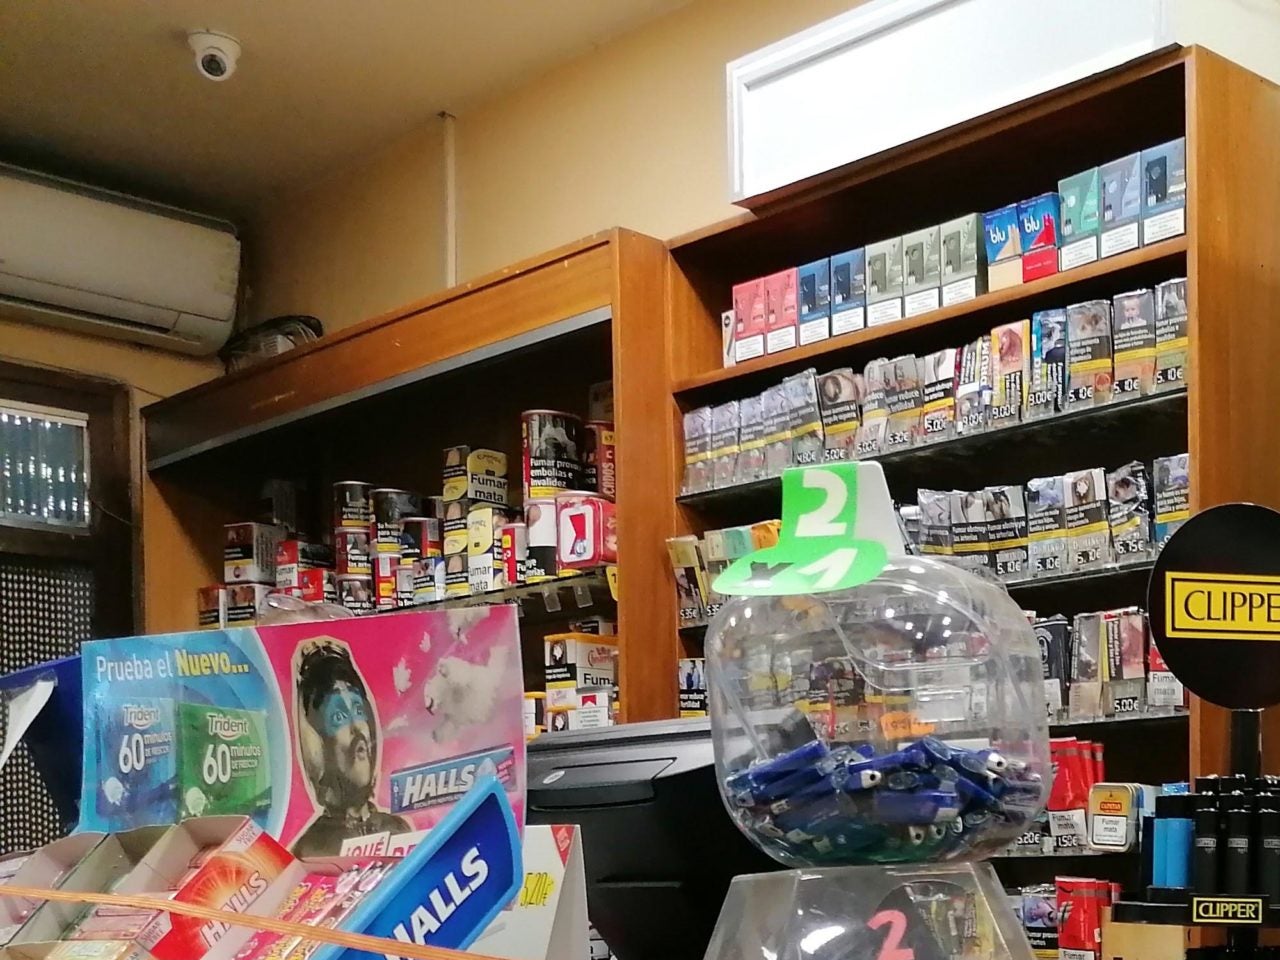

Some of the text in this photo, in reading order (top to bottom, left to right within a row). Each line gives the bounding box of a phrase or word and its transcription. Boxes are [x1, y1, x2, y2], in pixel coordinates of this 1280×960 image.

[1024, 215, 1040, 234] blu
[990, 228, 1006, 246] blu
[980, 341, 990, 385] DRUM
[471, 474, 507, 489] Fumar
[531, 477, 566, 488] invalidez
[475, 489, 504, 503] mata
[795, 468, 849, 537] 2
[97, 649, 249, 682] Prueba el Nuevo...
[208, 714, 248, 735] Trident
[119, 733, 145, 773] 60
[203, 743, 261, 785] 60 minutos
[403, 764, 475, 807] HALLS
[1102, 818, 1120, 826] Fumar
[1198, 901, 1258, 919] CLIPPER
